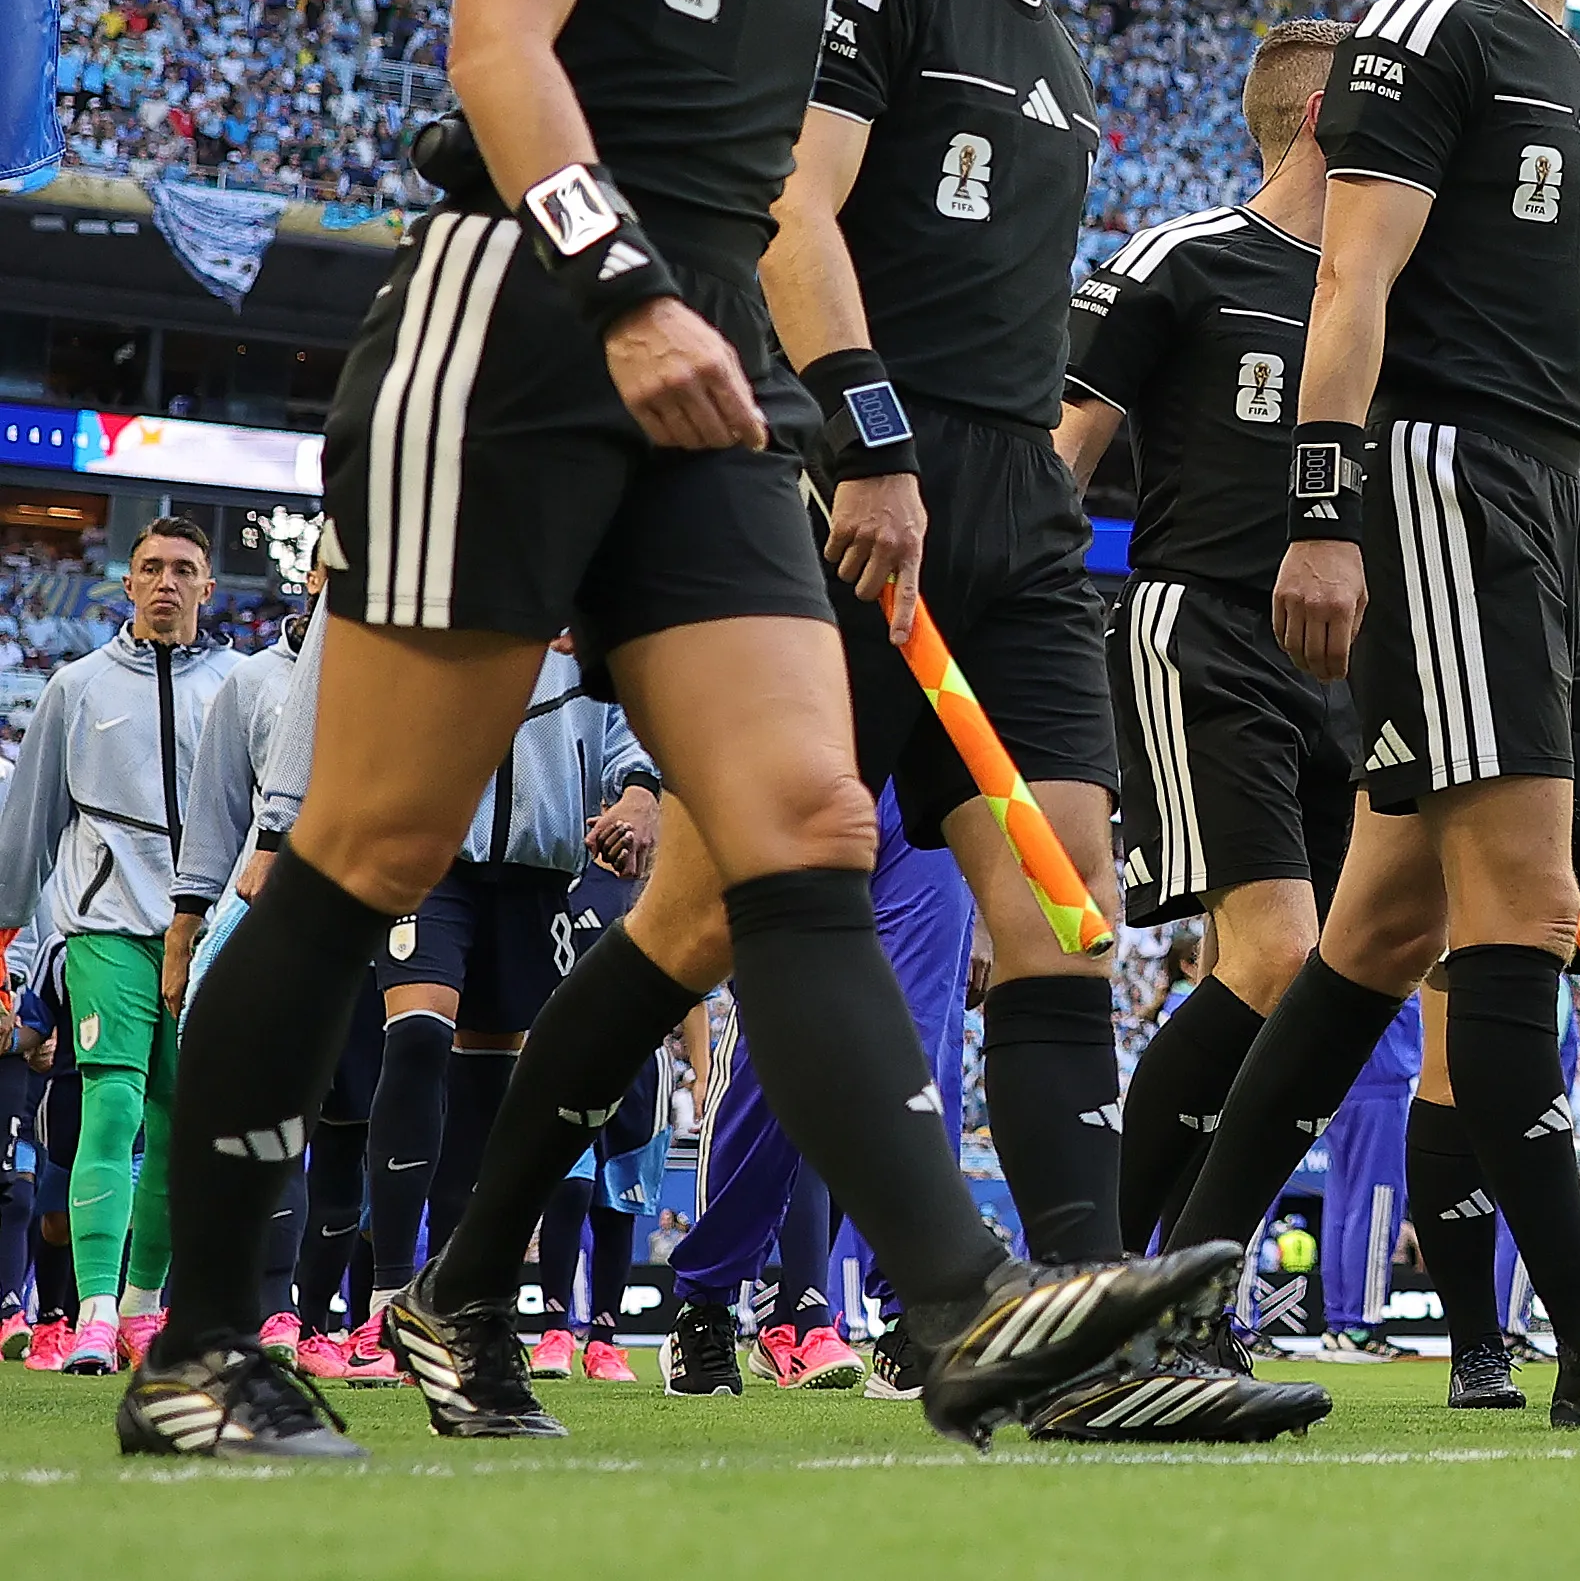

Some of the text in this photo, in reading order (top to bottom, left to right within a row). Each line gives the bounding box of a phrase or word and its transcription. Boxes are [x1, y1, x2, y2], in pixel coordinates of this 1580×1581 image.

[825, 11, 857, 44] FA
[829, 41, 858, 59] ONE
[1352, 54, 1404, 85] FIFA
[1350, 81, 1401, 101] TEAM ONE
[951, 201, 975, 212] FIFA
[1524, 204, 1546, 215] FIFA
[1077, 279, 1118, 304] FIFA
[1090, 302, 1109, 317] ONE
[1248, 407, 1269, 416] FIFA
[550, 912, 575, 976] 8
